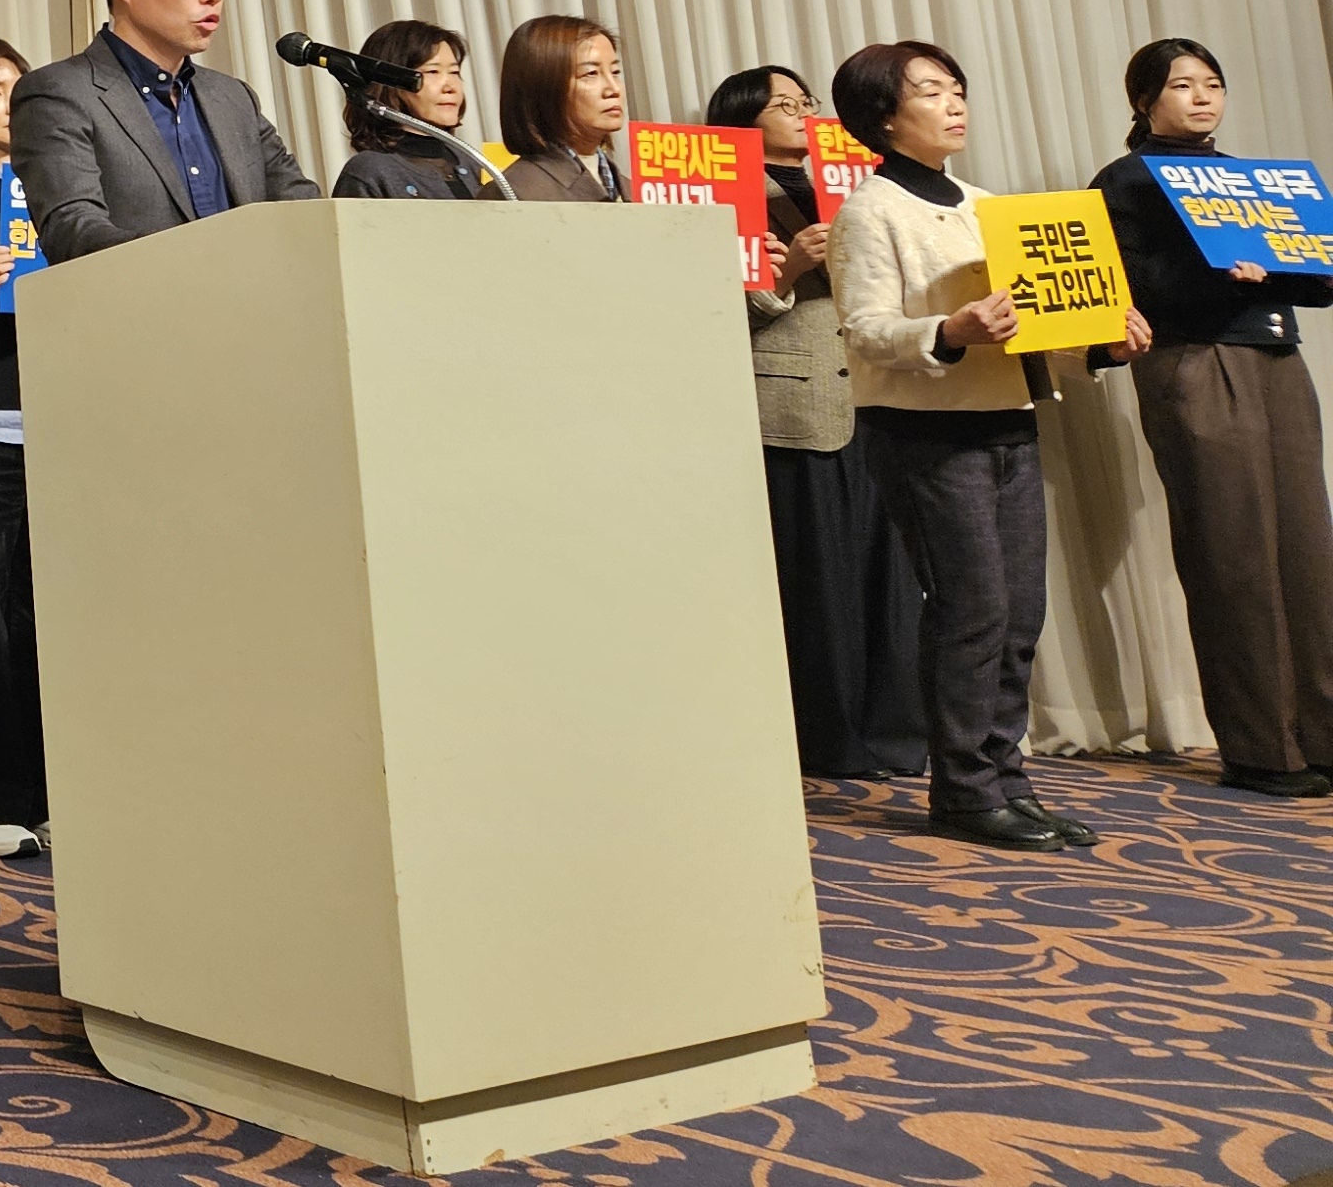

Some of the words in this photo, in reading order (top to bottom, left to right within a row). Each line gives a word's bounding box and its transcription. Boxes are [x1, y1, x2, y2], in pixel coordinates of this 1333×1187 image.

[637, 130, 737, 180] 한약사는
[1161, 166, 1257, 196] 약사는
[1255, 170, 1321, 199] 약국
[1179, 196, 1305, 231] 한약사는
[1018, 220, 1095, 265] 국민은
[1010, 266, 1119, 315] 속고있다!
